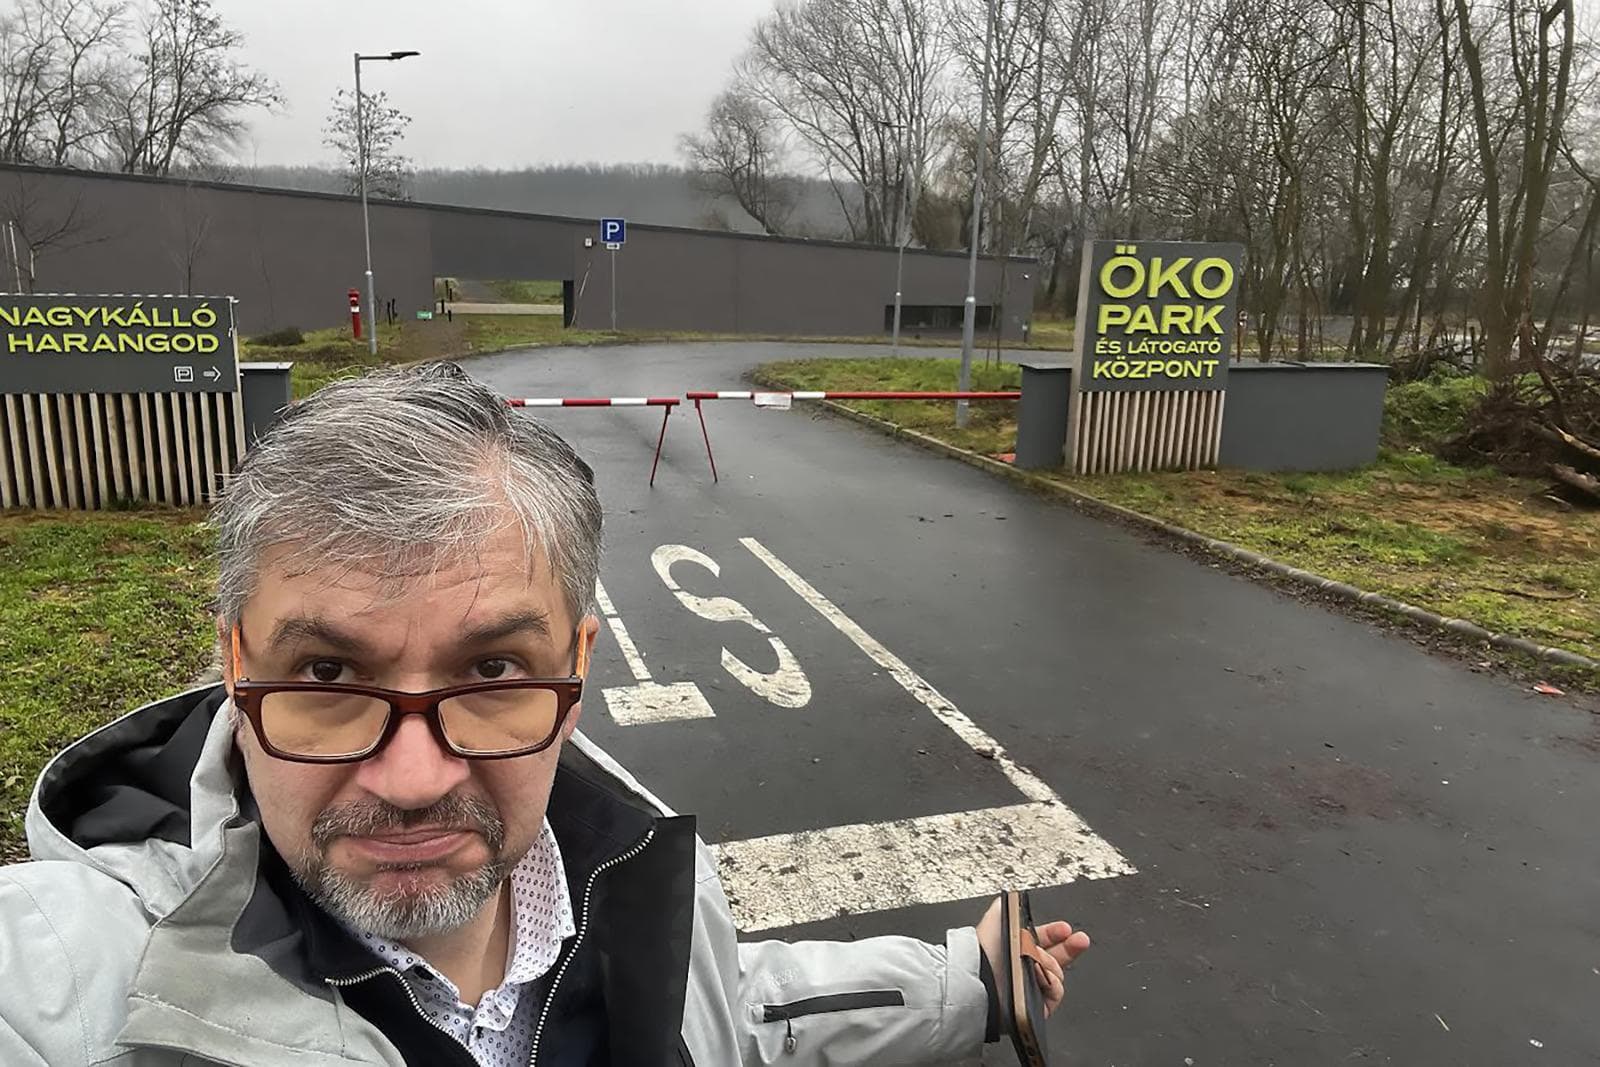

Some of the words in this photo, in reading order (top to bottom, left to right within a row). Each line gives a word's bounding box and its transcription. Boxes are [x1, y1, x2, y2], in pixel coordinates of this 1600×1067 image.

[606, 221, 620, 240] P
[1100, 245, 1234, 299] ÖKO
[0, 302, 217, 328] NAGYKÁLLÓ
[1097, 304, 1226, 335] PARK
[8, 333, 219, 353] HARANGOD
[1096, 337, 1122, 354] ÉS
[1127, 337, 1222, 354] LÁTOGATÓ
[1093, 356, 1219, 379] KÖZPONT
